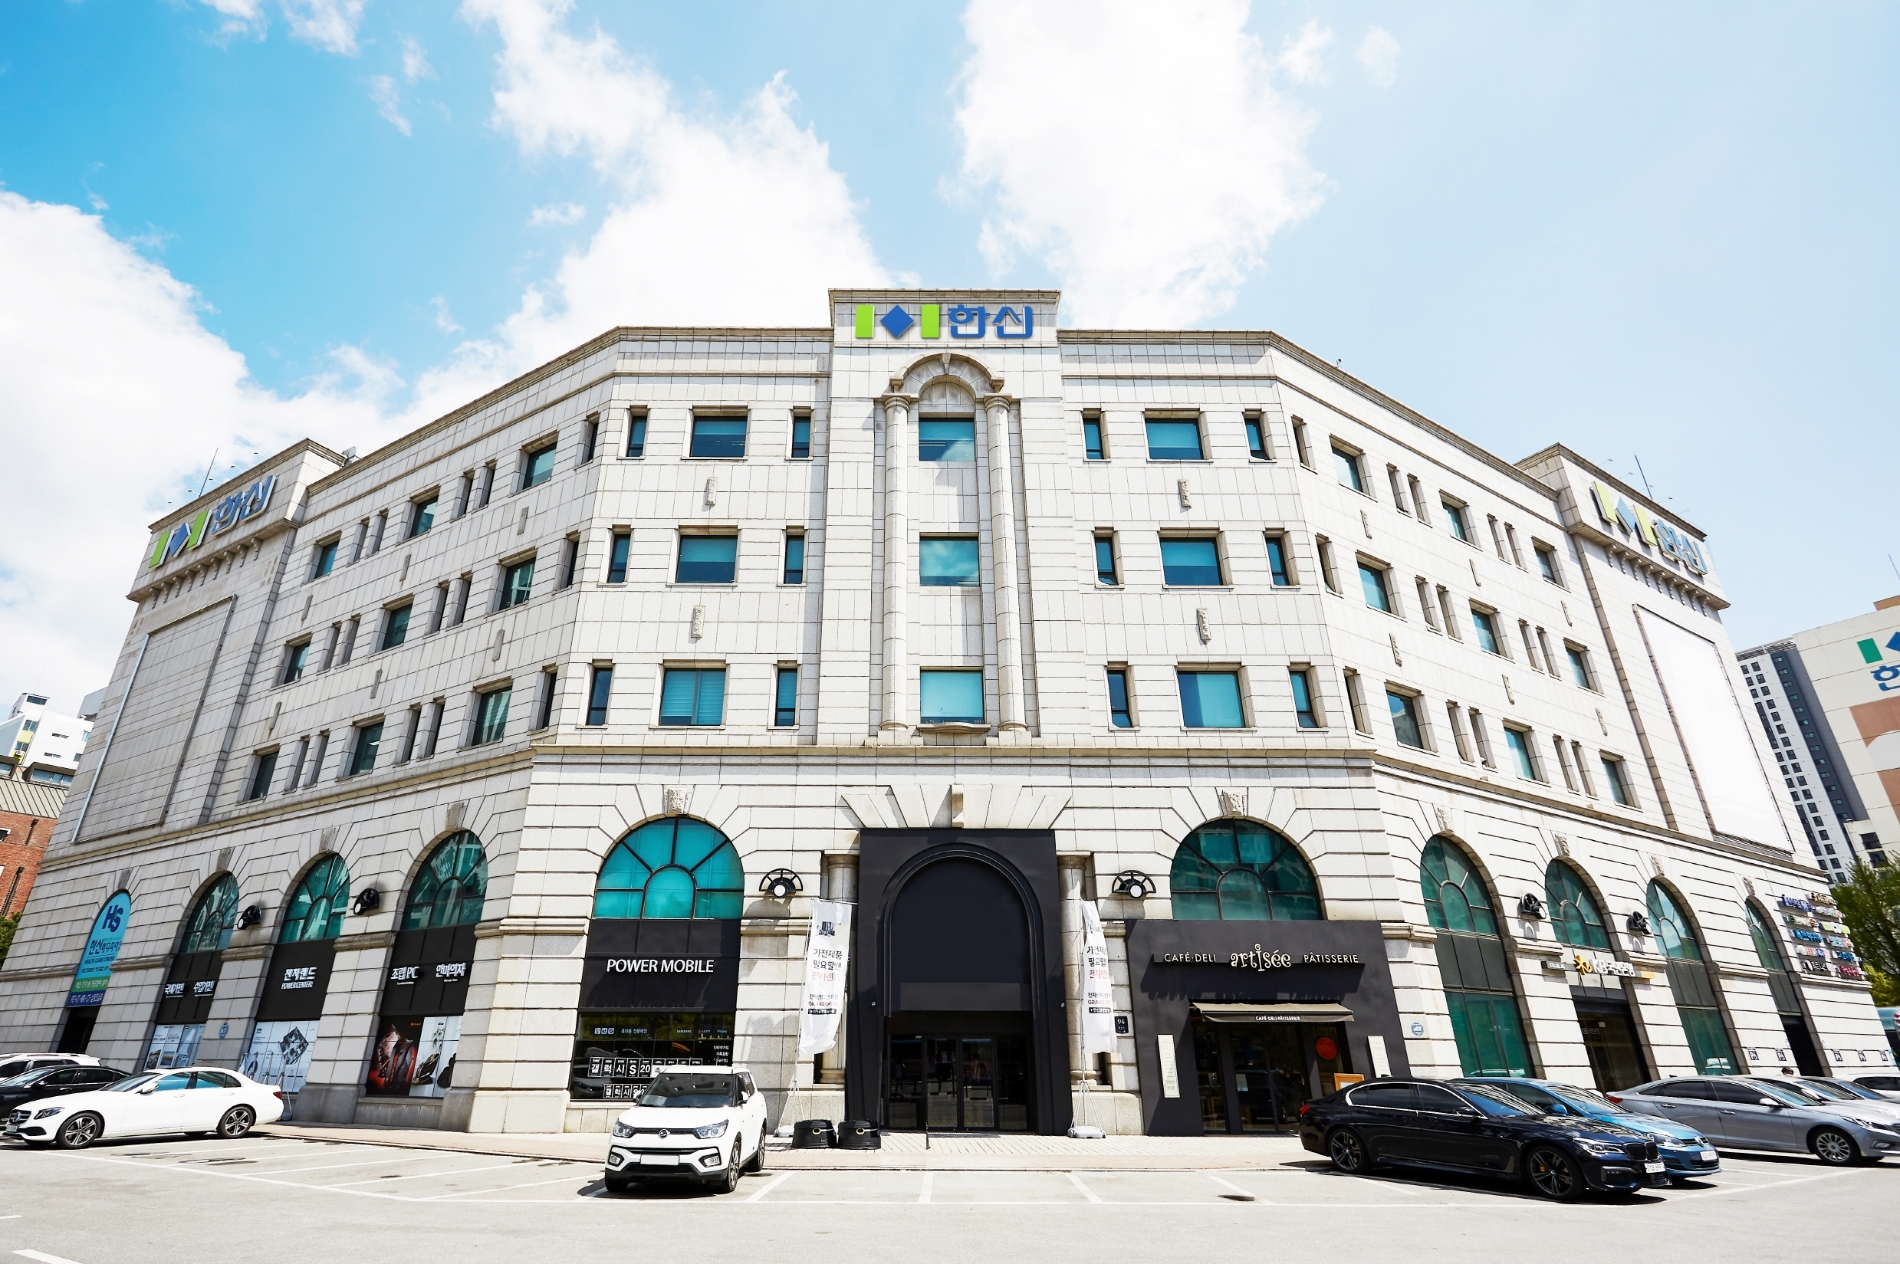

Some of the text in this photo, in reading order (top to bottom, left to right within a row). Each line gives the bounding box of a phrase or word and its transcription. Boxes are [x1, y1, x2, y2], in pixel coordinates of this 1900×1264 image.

[948, 304, 1033, 338] 한신
[211, 475, 276, 535] 한신
[1653, 518, 1708, 575] 한신
[102, 904, 123, 932] HS
[607, 959, 715, 973] POWER MOBILE
[813, 949, 842, 960] 가전제품
[1230, 943, 1291, 971] artisée
[1303, 951, 1359, 964] PÂTISSERIE
[284, 967, 317, 982] 전자랜드
[436, 963, 467, 978] 안마의자
